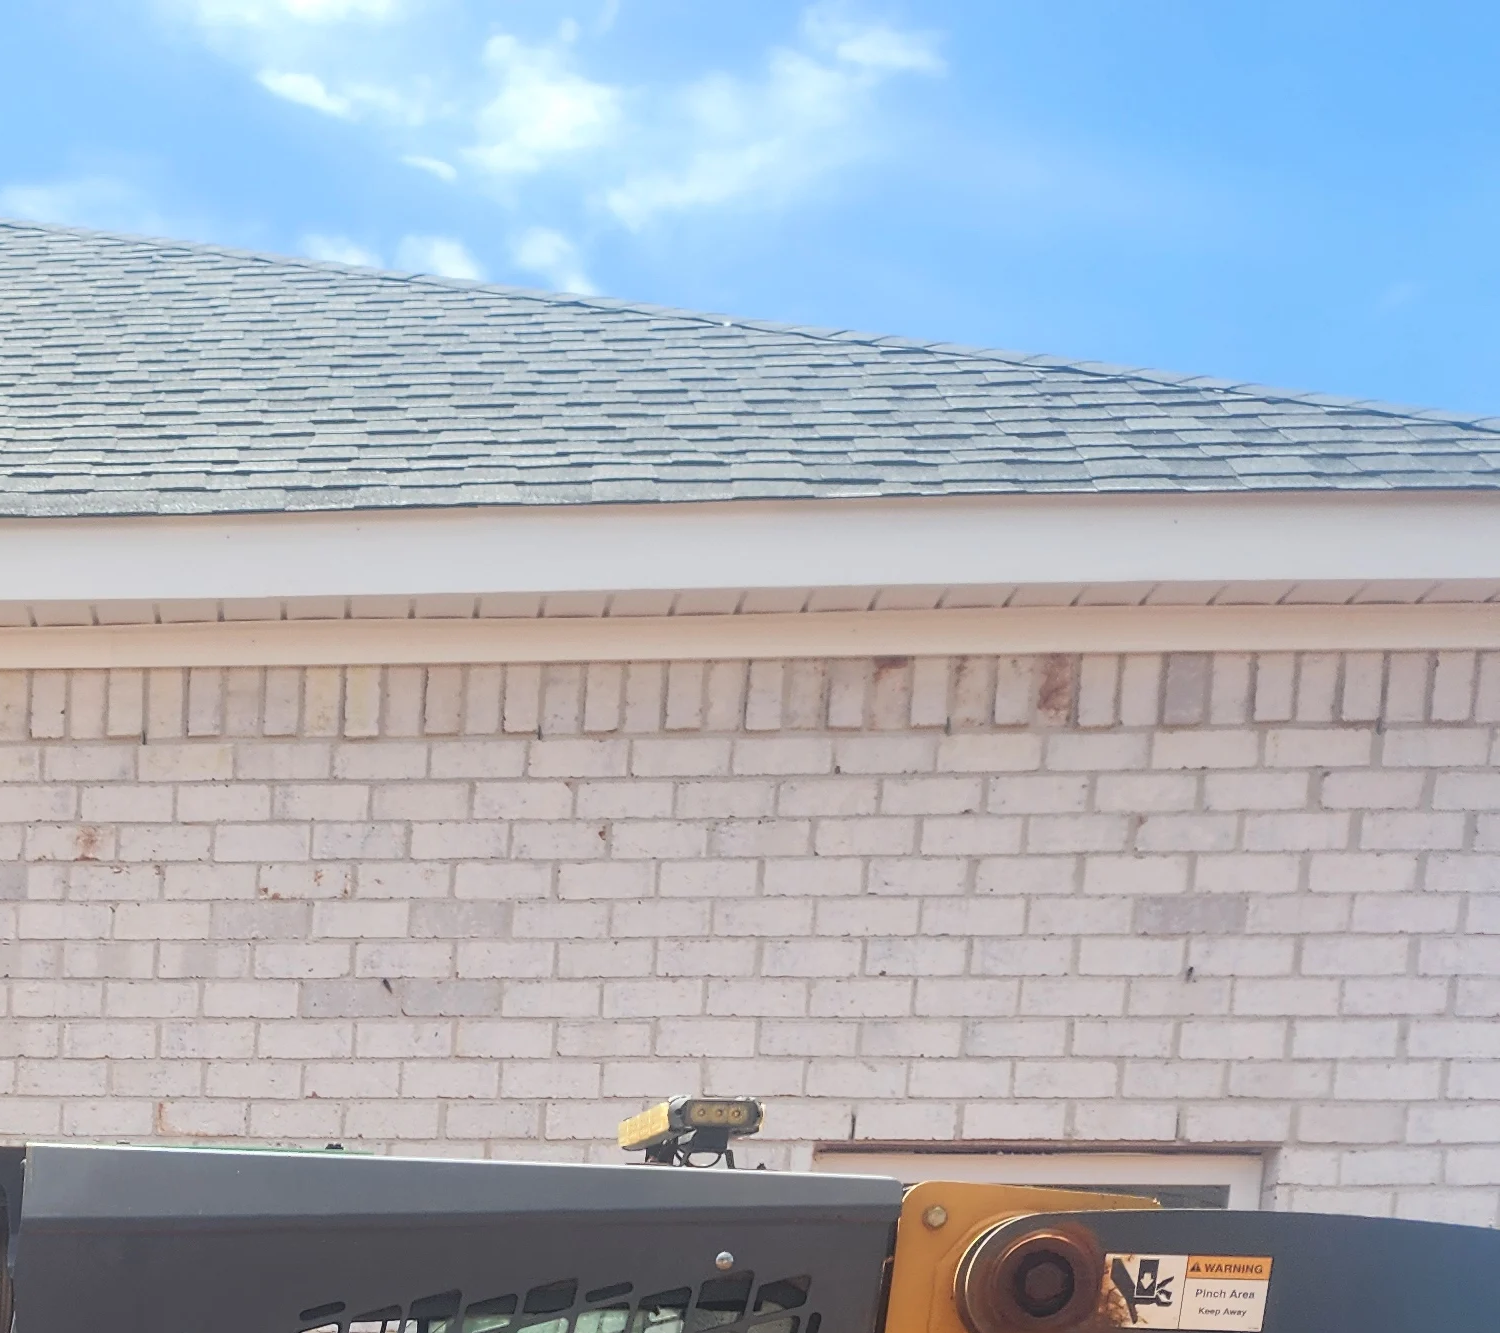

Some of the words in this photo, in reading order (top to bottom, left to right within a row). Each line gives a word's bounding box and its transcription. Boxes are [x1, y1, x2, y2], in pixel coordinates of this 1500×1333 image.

[1204, 1263, 1263, 1274] WARNING
[1195, 1288, 1226, 1299] Pinch
[1229, 1288, 1255, 1299] Area
[1198, 1306, 1221, 1317] Keep
[1223, 1308, 1247, 1317] Away
